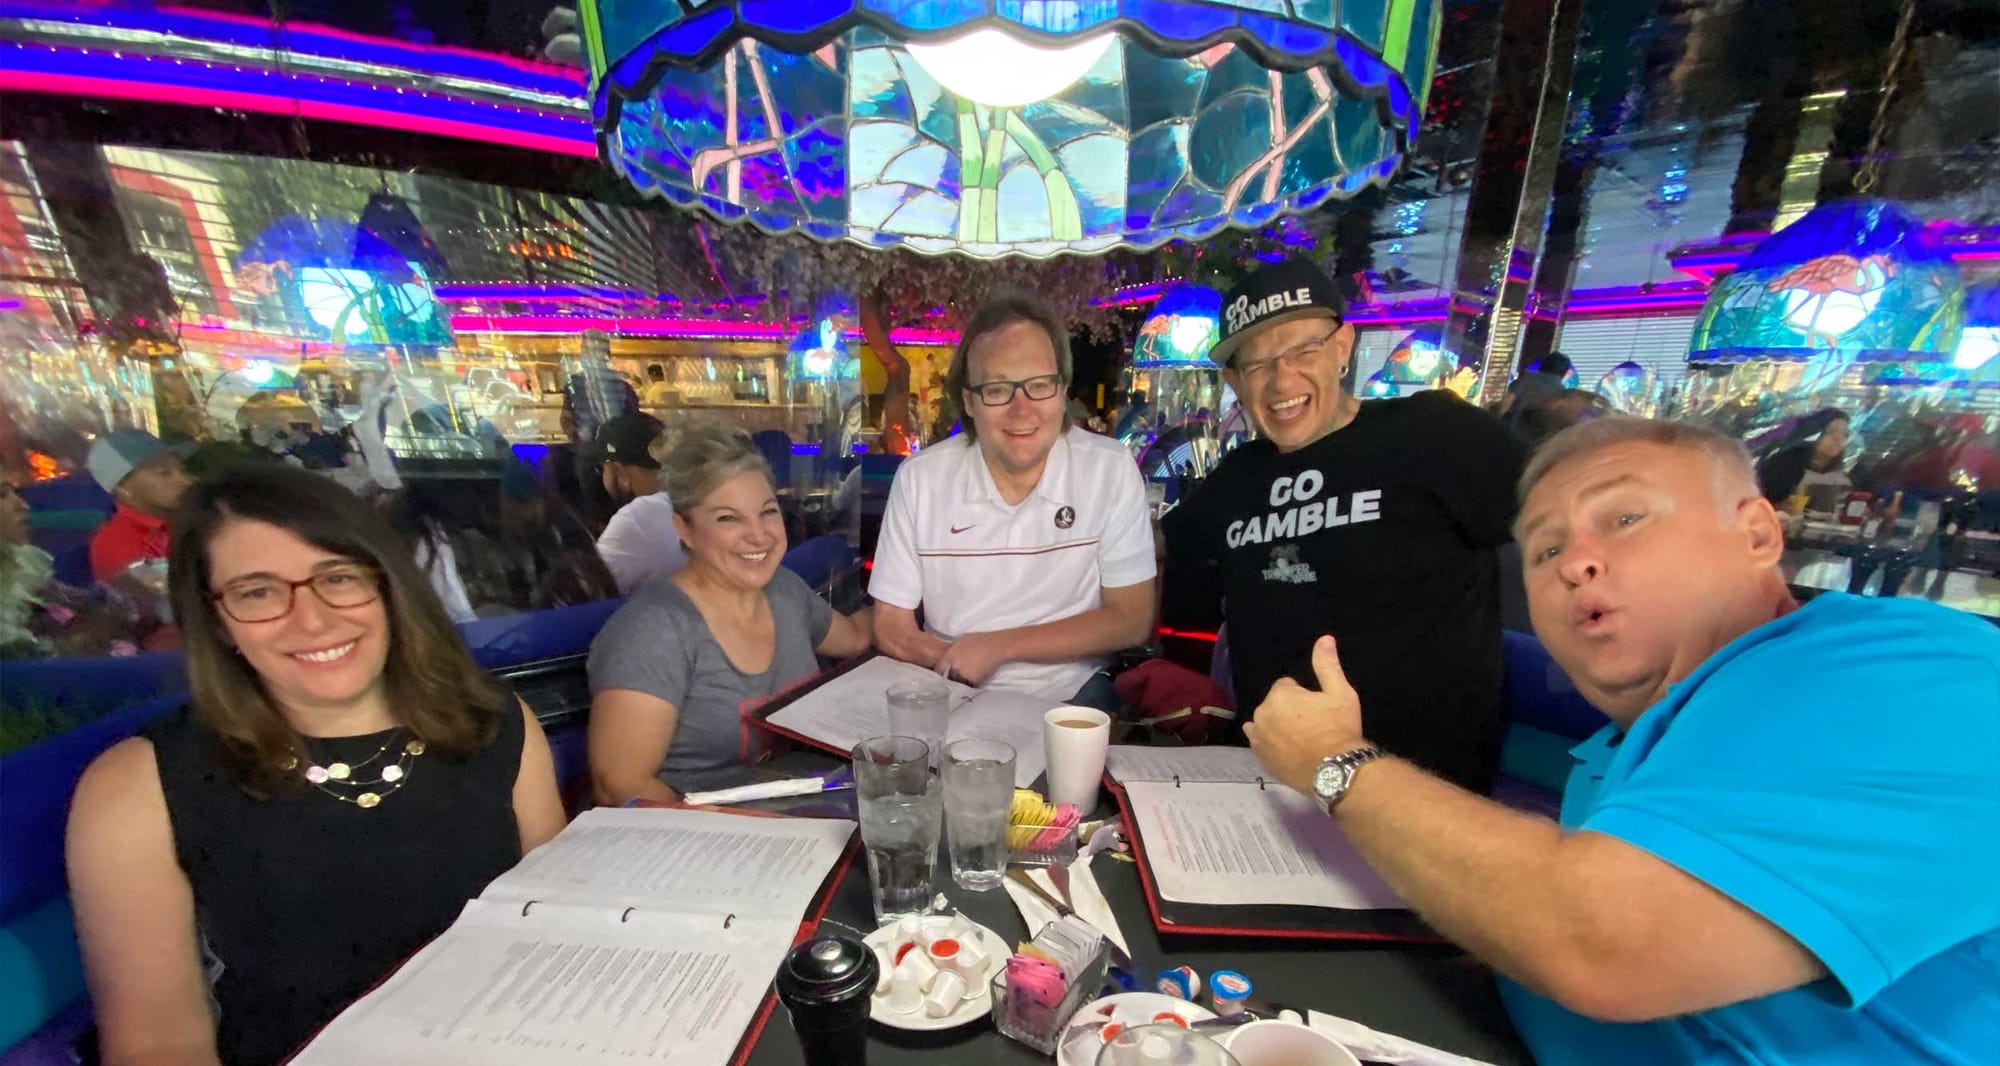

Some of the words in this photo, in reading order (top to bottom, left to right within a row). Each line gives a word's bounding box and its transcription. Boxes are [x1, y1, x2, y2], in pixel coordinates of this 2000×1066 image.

[1225, 294, 1248, 321] GO
[1228, 287, 1312, 335] GAMBLE
[1269, 469, 1324, 507] GO
[1226, 489, 1382, 549] GAMBLE
